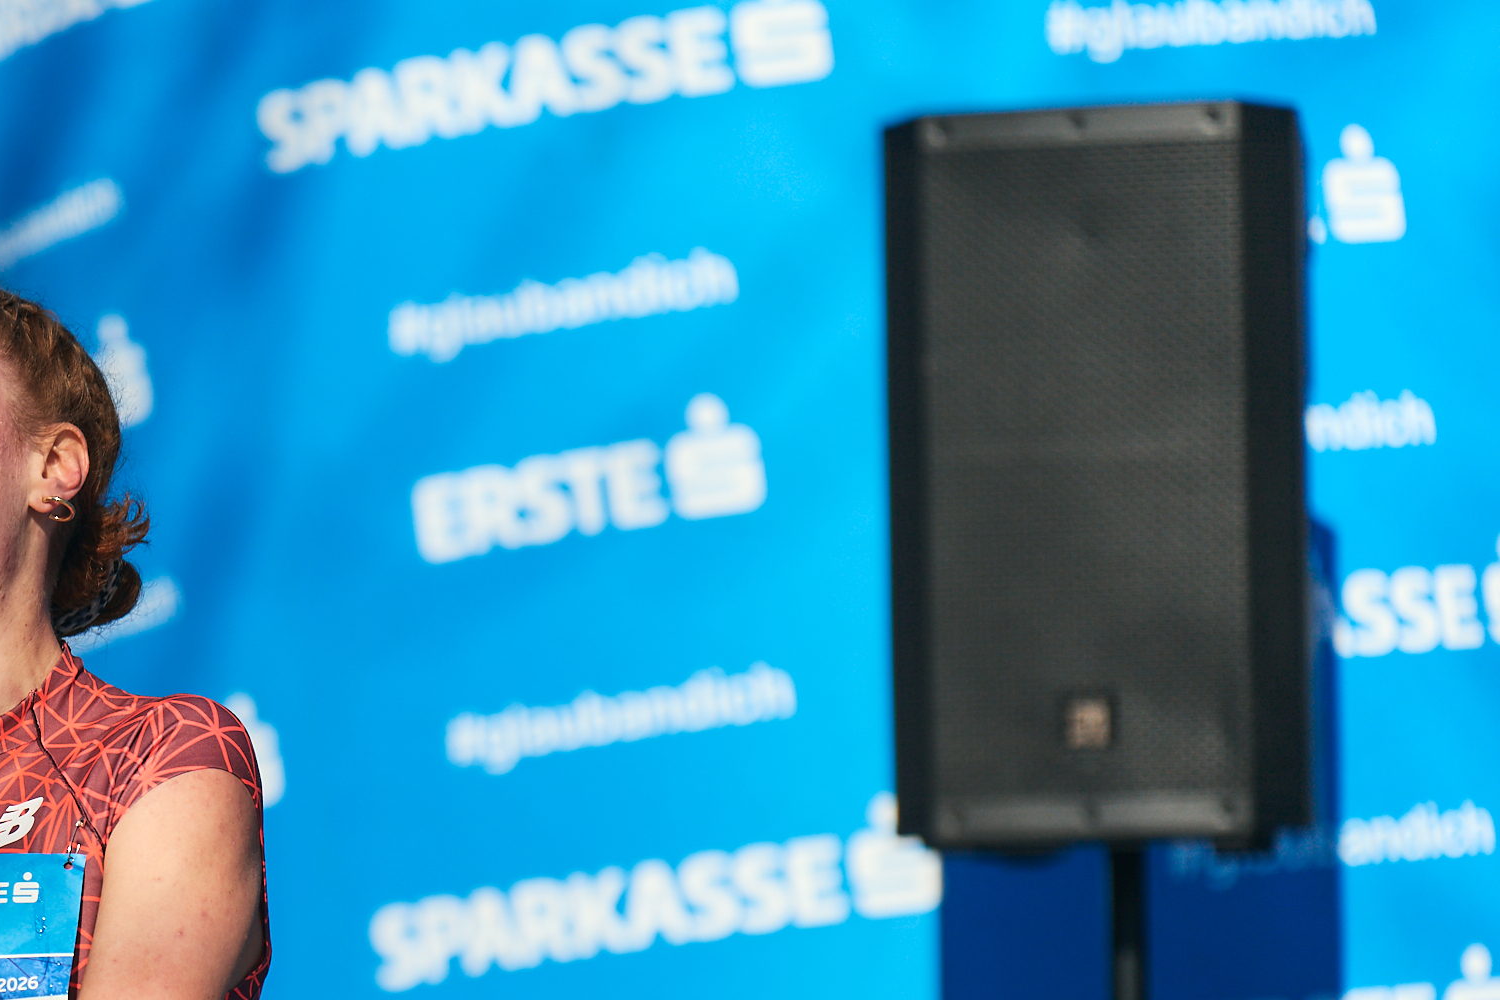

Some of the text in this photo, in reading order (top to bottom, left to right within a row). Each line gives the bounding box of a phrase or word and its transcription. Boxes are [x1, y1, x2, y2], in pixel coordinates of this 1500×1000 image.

[257, 5, 735, 174] SPARKASSE
[411, 437, 669, 563] ERSTE
[369, 834, 849, 992] SPARKASSE
